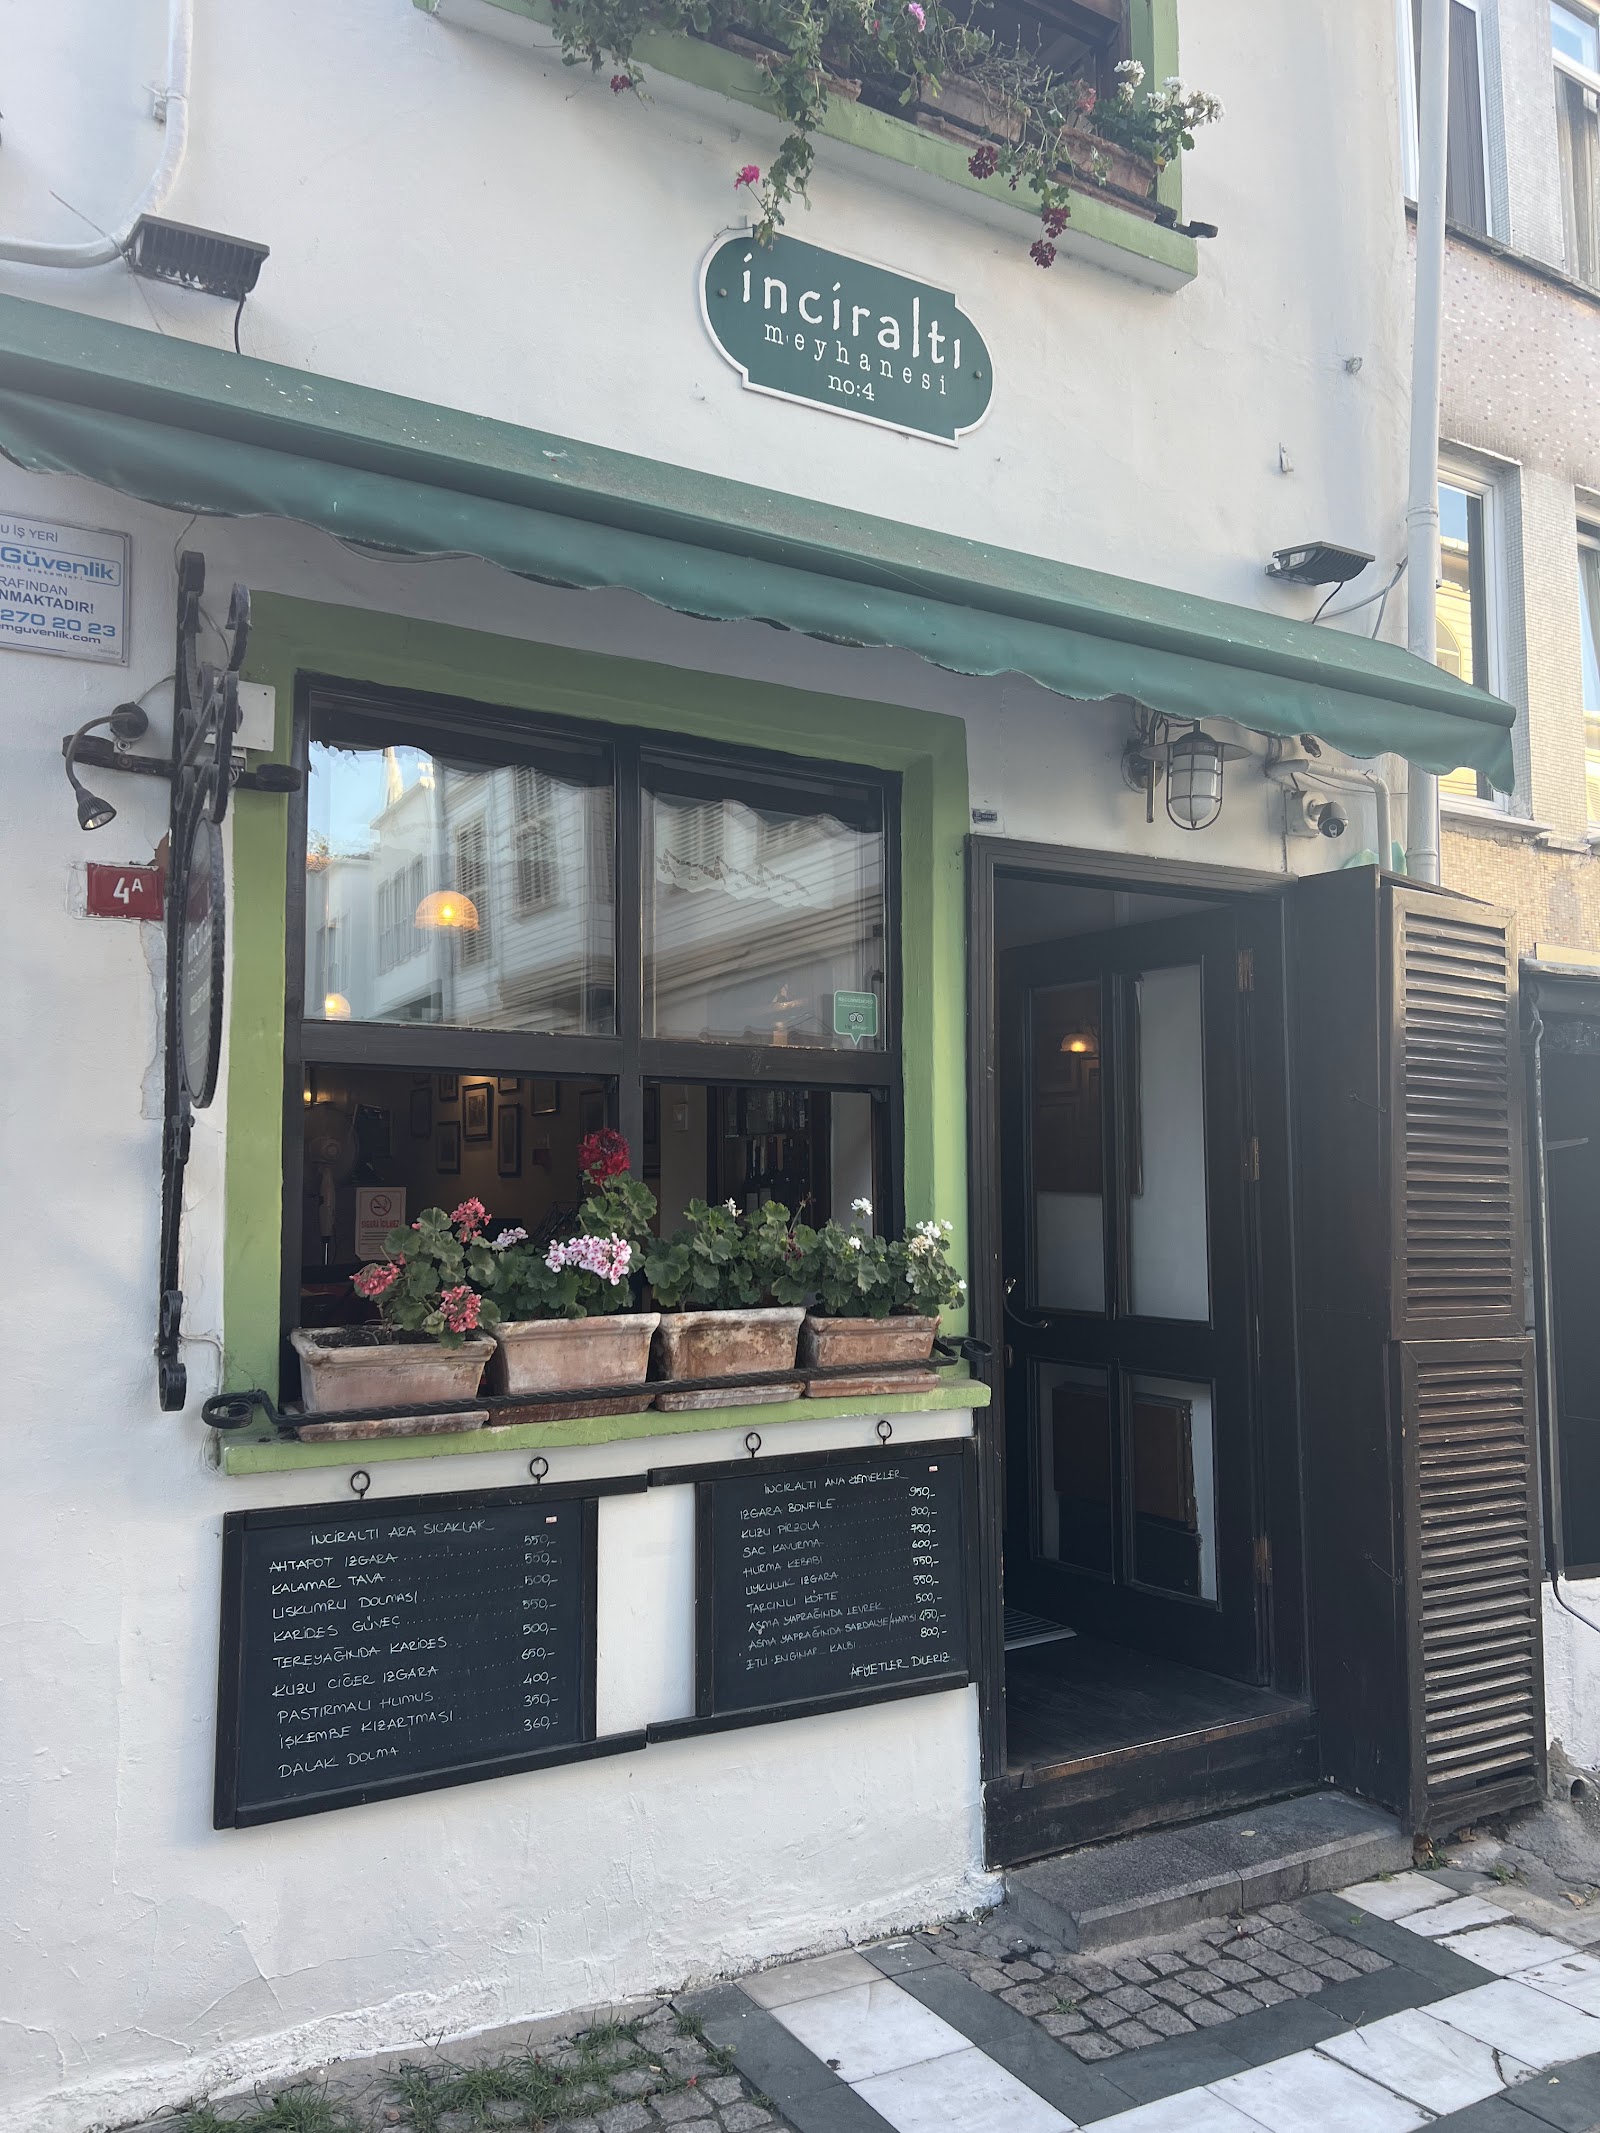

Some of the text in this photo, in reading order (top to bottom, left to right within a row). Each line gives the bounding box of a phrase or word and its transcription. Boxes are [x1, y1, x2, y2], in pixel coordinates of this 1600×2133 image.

[764, 322, 947, 395] meyhanesi
[827, 374, 875, 401] no:4
[13, 526, 26, 539] İŞ
[29, 529, 58, 543] YERİ
[0, 546, 114, 581] Güvenlik
[0, 608, 116, 638] 270 20 23
[825, 1477, 846, 1488] ANA
[740, 1505, 783, 1520] IZGARA
[788, 1498, 836, 1513] BONFİLE
[388, 1525, 417, 1538] ARA
[423, 1519, 495, 1535] SICAKLAR
[741, 1527, 771, 1538] KUZU
[742, 1546, 767, 1558] SAC
[772, 1538, 824, 1553] KAVURMA
[269, 1557, 334, 1573] AHTAPOT
[345, 1552, 398, 1567] IZGARA
[743, 1562, 782, 1578] HURMA
[787, 1556, 823, 1568] KEBABI
[272, 1577, 342, 1595] KALAMAR
[348, 1572, 386, 1586] TAVA
[745, 1578, 795, 1595] UYKULUK
[800, 1571, 839, 1585] IZGARA
[272, 1599, 347, 1619] USKUMRU
[358, 1591, 418, 1608] DOLMASI
[847, 1601, 885, 1616] LEVREK
[273, 1624, 338, 1643] KARİDES
[748, 1637, 777, 1651] ASMA
[390, 1636, 447, 1654] KARİDES
[272, 1682, 316, 1697] KUZU
[383, 1666, 438, 1684] IZGARA
[277, 1699, 371, 1724] PASTIRMALI
[379, 1691, 434, 1709] HUMUS
[361, 1710, 453, 1733] KIZARTMASI
[278, 1757, 339, 1778] DALAK
[346, 1746, 399, 1766] DOLMA
